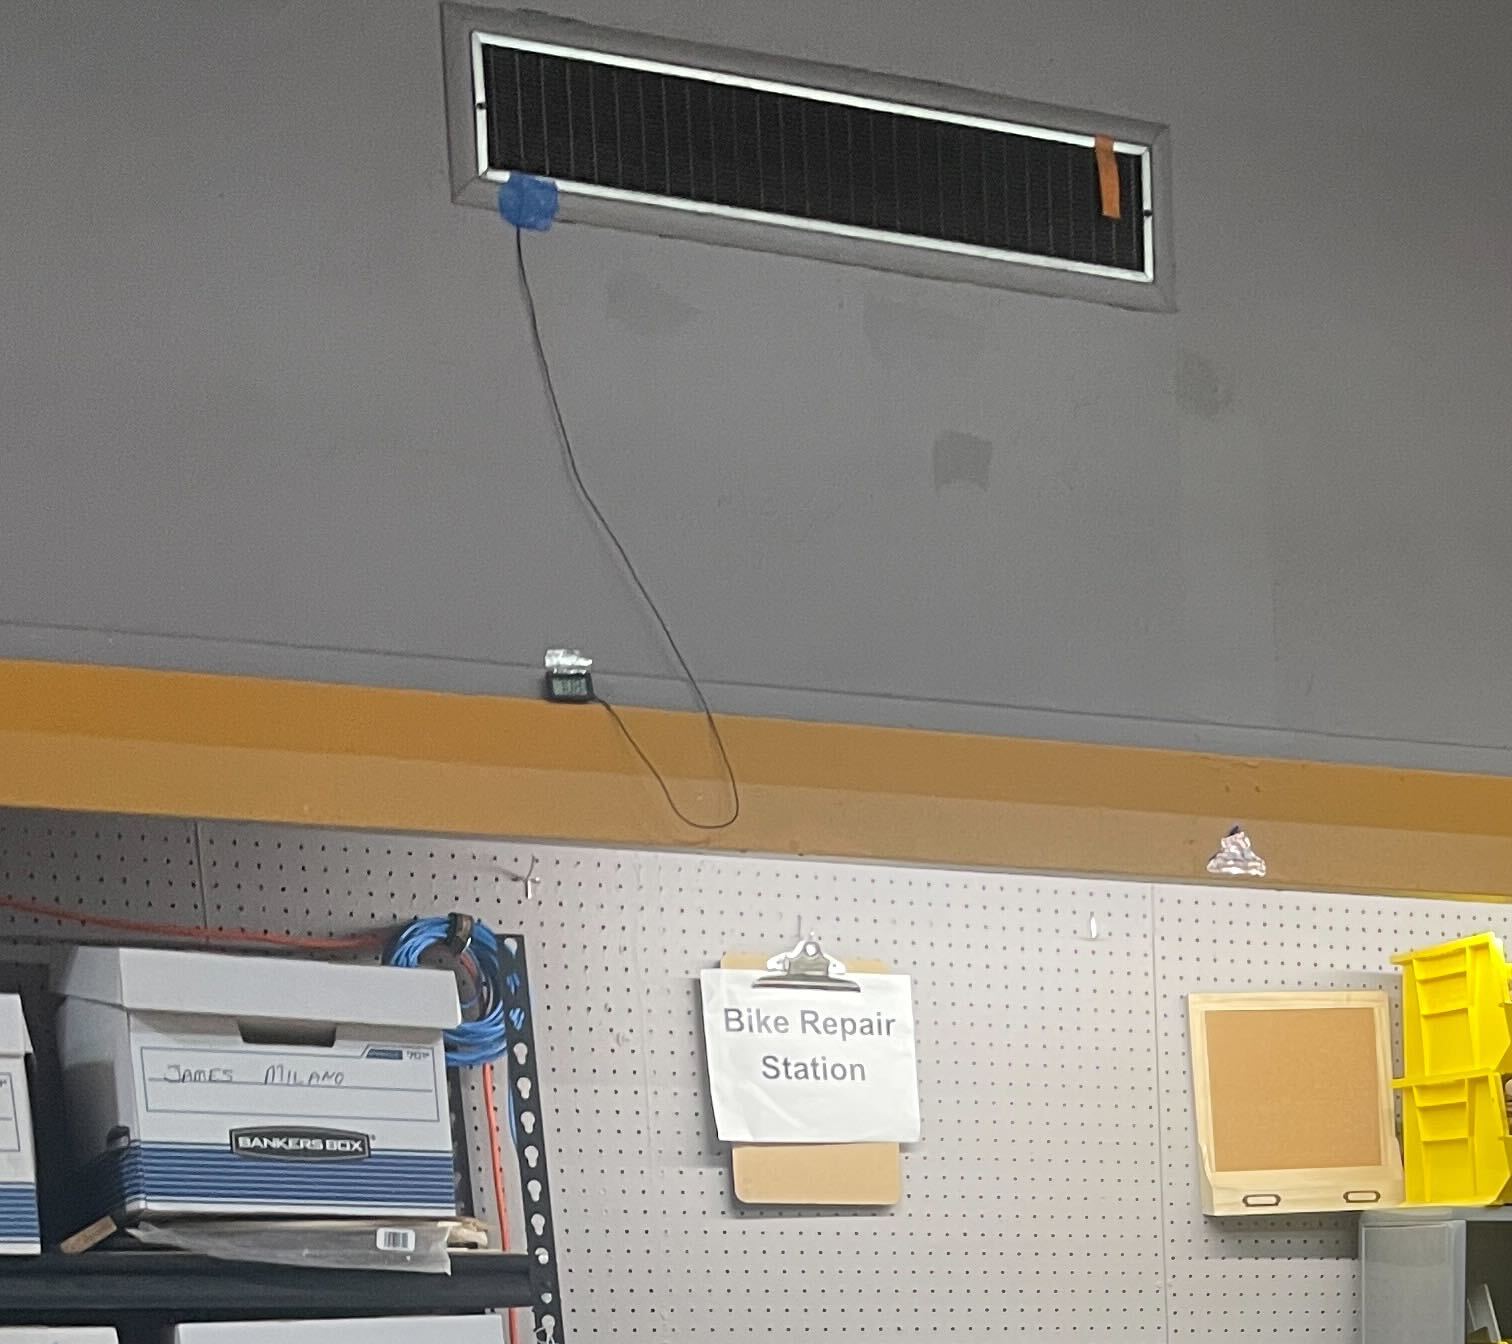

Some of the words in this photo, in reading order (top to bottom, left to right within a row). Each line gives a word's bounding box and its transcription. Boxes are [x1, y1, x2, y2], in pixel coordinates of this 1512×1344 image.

[723, 1007, 790, 1034] Bike
[800, 1009, 896, 1041] Repair
[762, 1055, 866, 1081] Station
[238, 1136, 323, 1151] BANKERS
[326, 1139, 363, 1152] BOX
